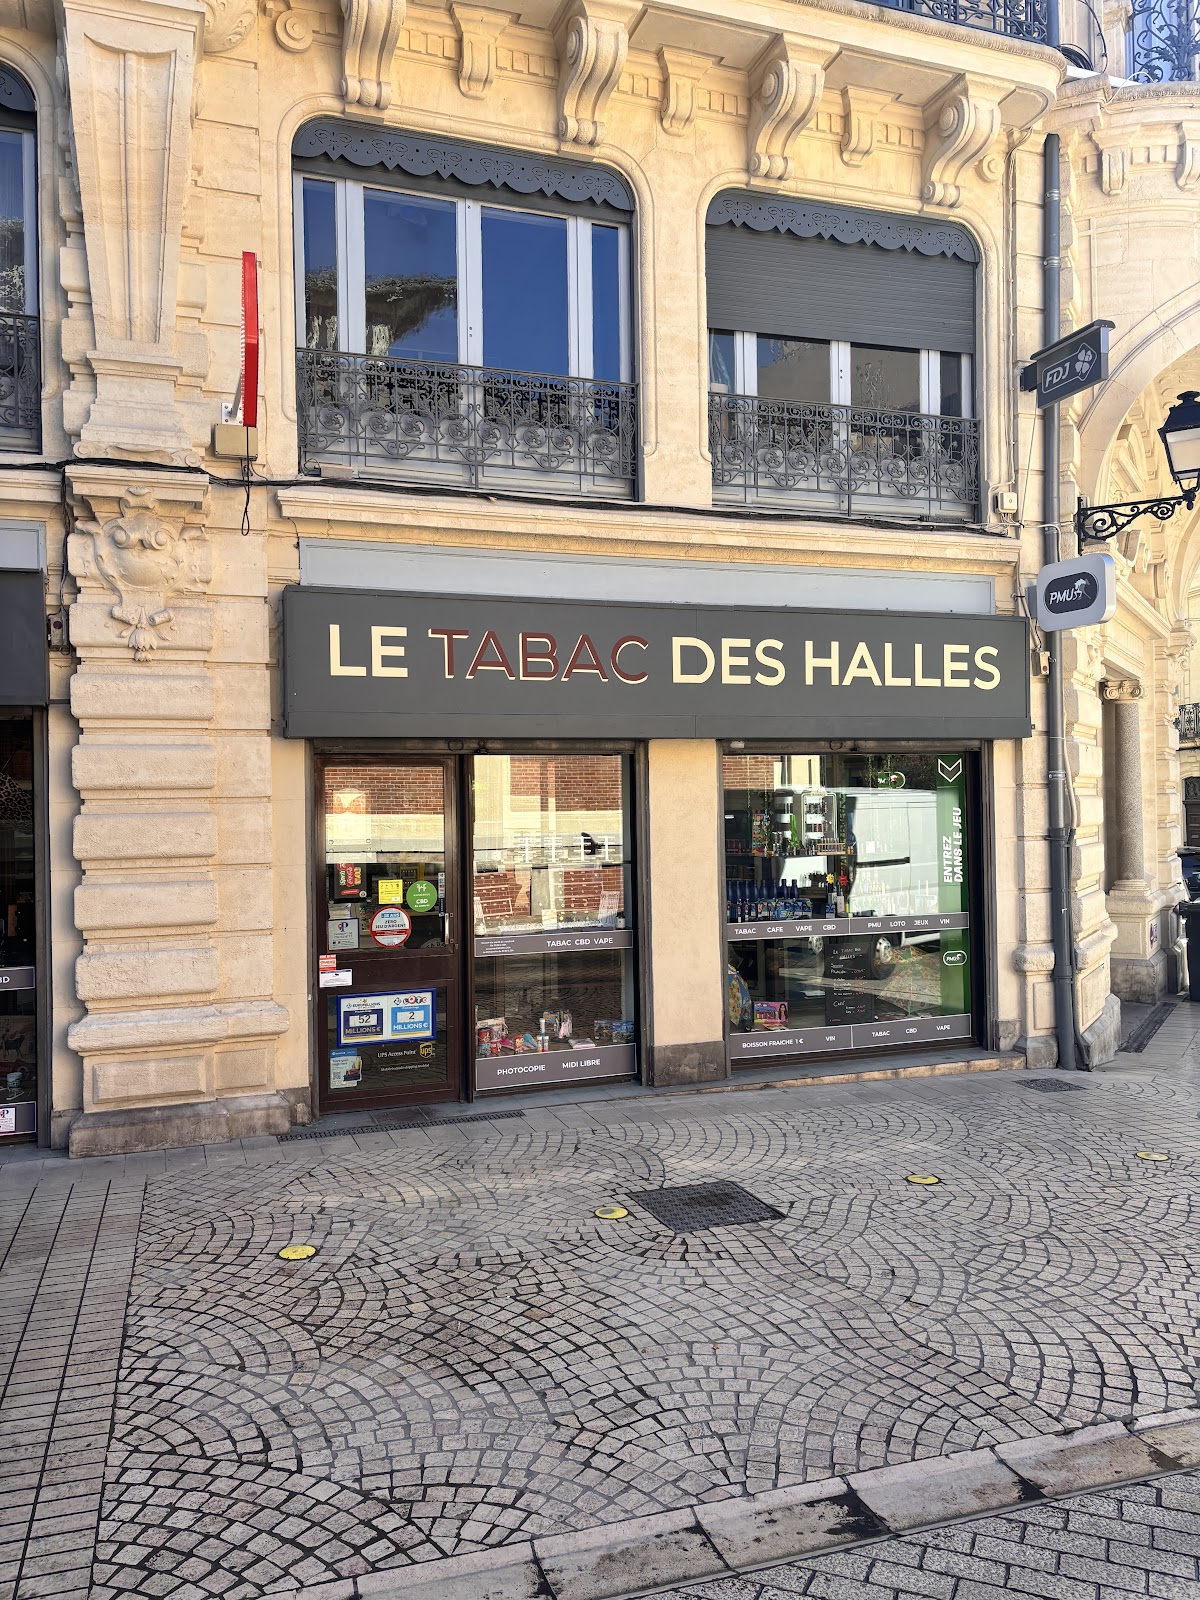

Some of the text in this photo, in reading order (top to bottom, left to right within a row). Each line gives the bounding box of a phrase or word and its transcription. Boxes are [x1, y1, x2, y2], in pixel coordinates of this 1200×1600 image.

[1045, 362, 1070, 388] FDJ
[1050, 588, 1074, 605] PMU
[328, 624, 1001, 690] LE TABAC DES HALLES
[952, 807, 964, 882] DANS LE JEU
[942, 836, 953, 882] ENTREZ
[359, 1015, 370, 1024] 52
[497, 1064, 546, 1075] PHOTOCOPIE
[580, 1059, 600, 1067] LIBRE
